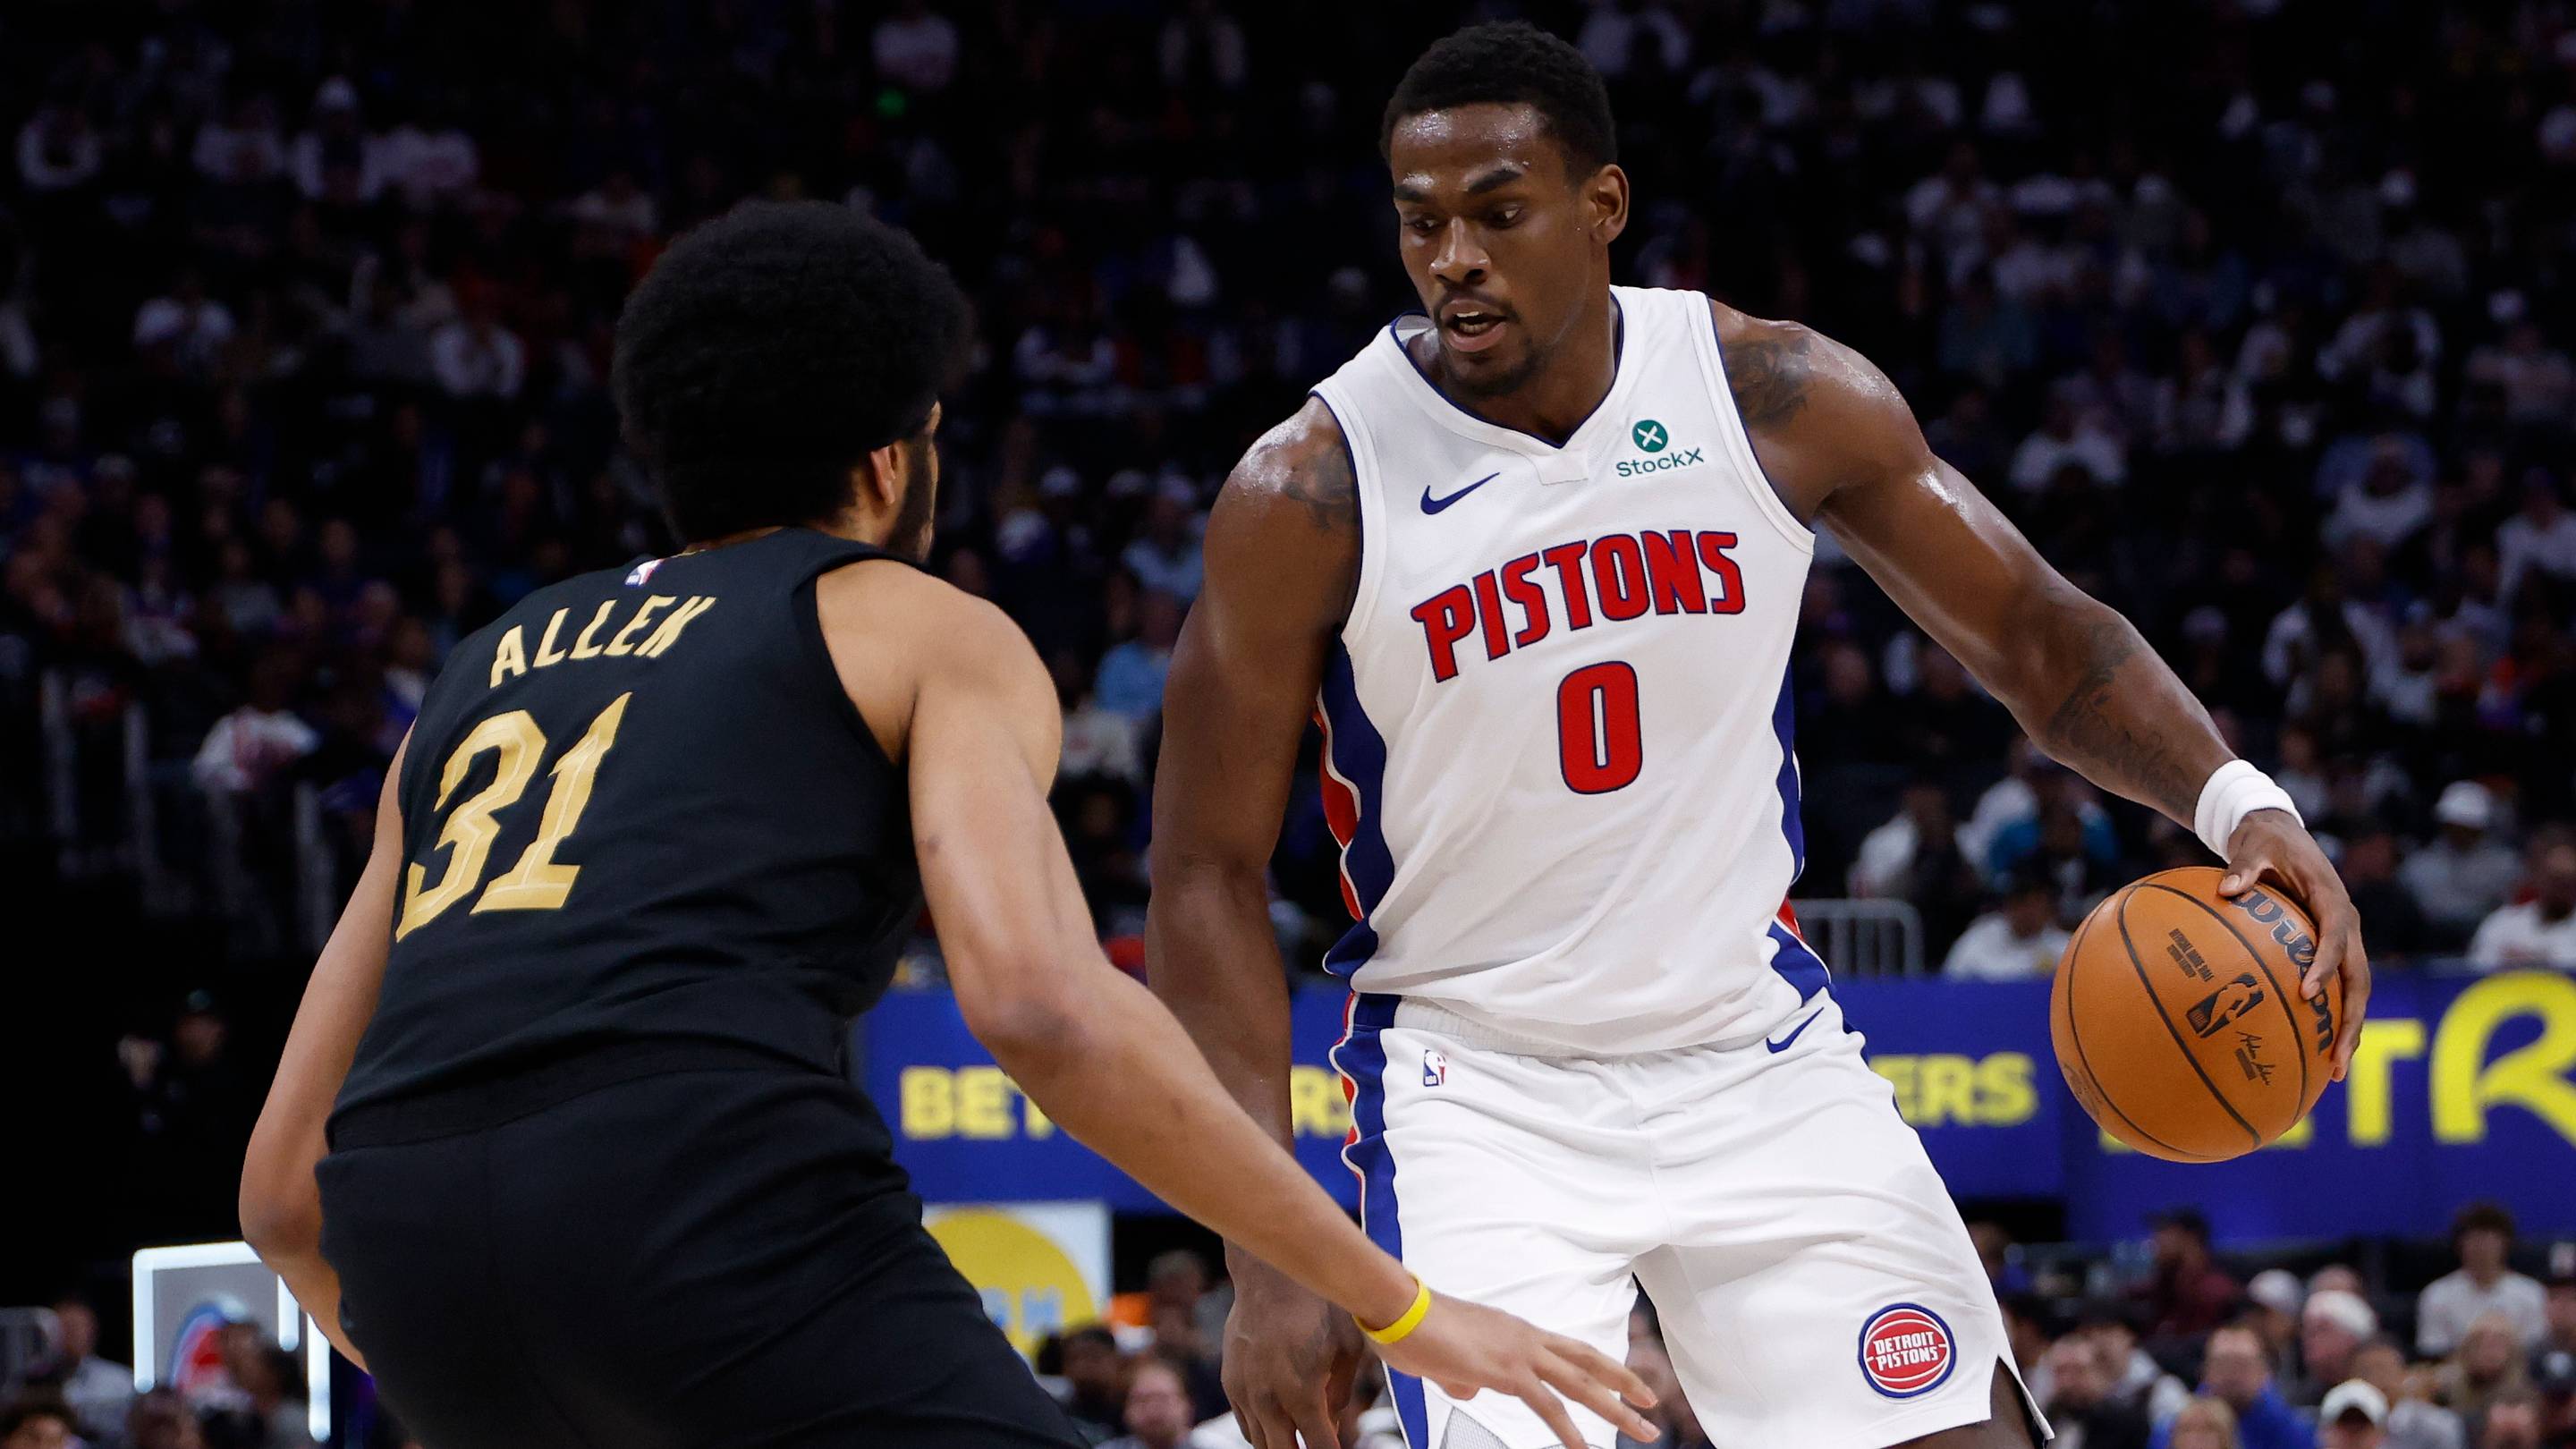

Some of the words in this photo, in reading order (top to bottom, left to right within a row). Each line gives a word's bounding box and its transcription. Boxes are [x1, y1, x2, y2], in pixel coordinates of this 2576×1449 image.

[1615, 446, 1704, 477] StockX
[488, 595, 716, 689] ALLEN
[1411, 530, 1745, 683] PISTONS
[1557, 660, 1643, 795] 0
[395, 691, 632, 944] 31
[2231, 887, 2334, 1055] Wilon
[1873, 1332, 1934, 1354] DETROIT
[1876, 1346, 1938, 1371] PISTONS
